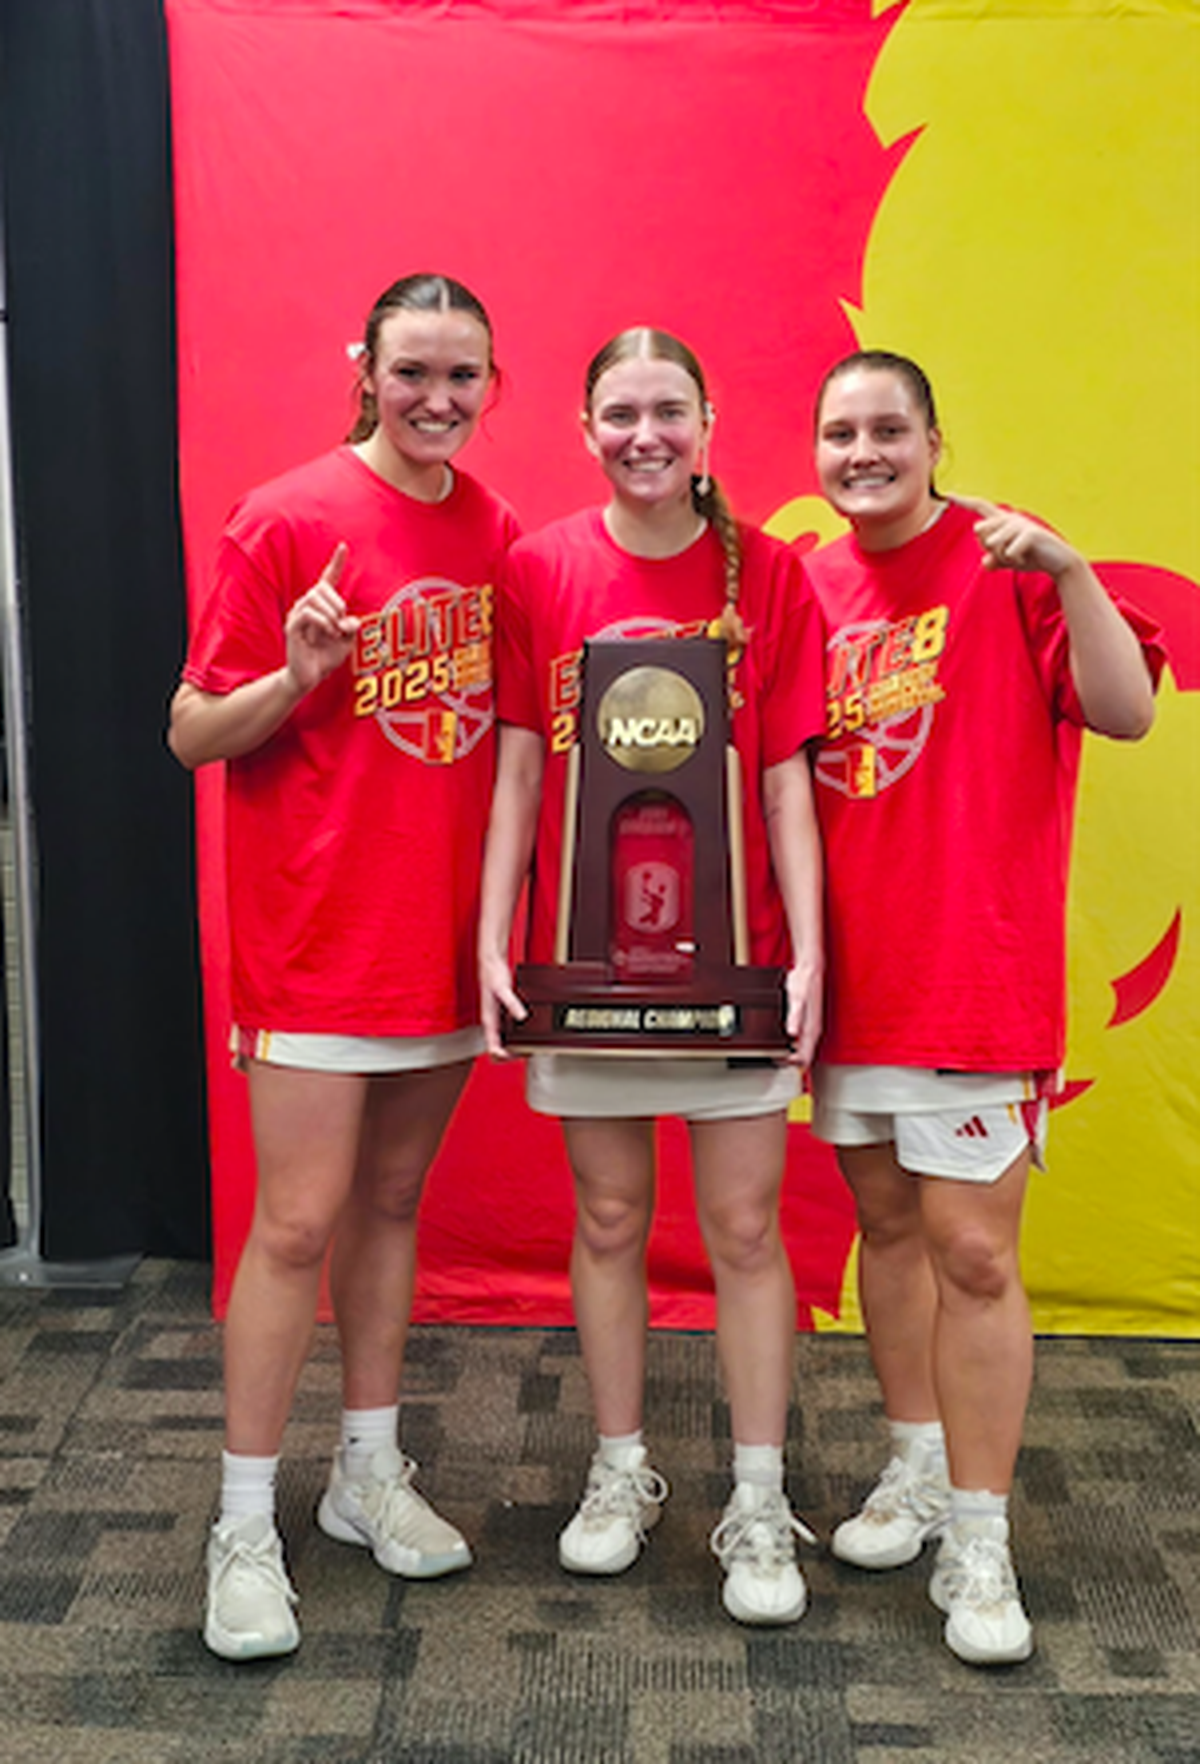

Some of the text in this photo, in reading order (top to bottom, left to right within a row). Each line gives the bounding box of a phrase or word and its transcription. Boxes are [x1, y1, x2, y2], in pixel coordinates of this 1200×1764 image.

[354, 587, 482, 675] ELITE
[827, 615, 918, 698] ITE
[911, 606, 949, 662] 8
[355, 655, 450, 718] 2025
[827, 691, 866, 739] 25
[608, 717, 697, 747] NCAA
